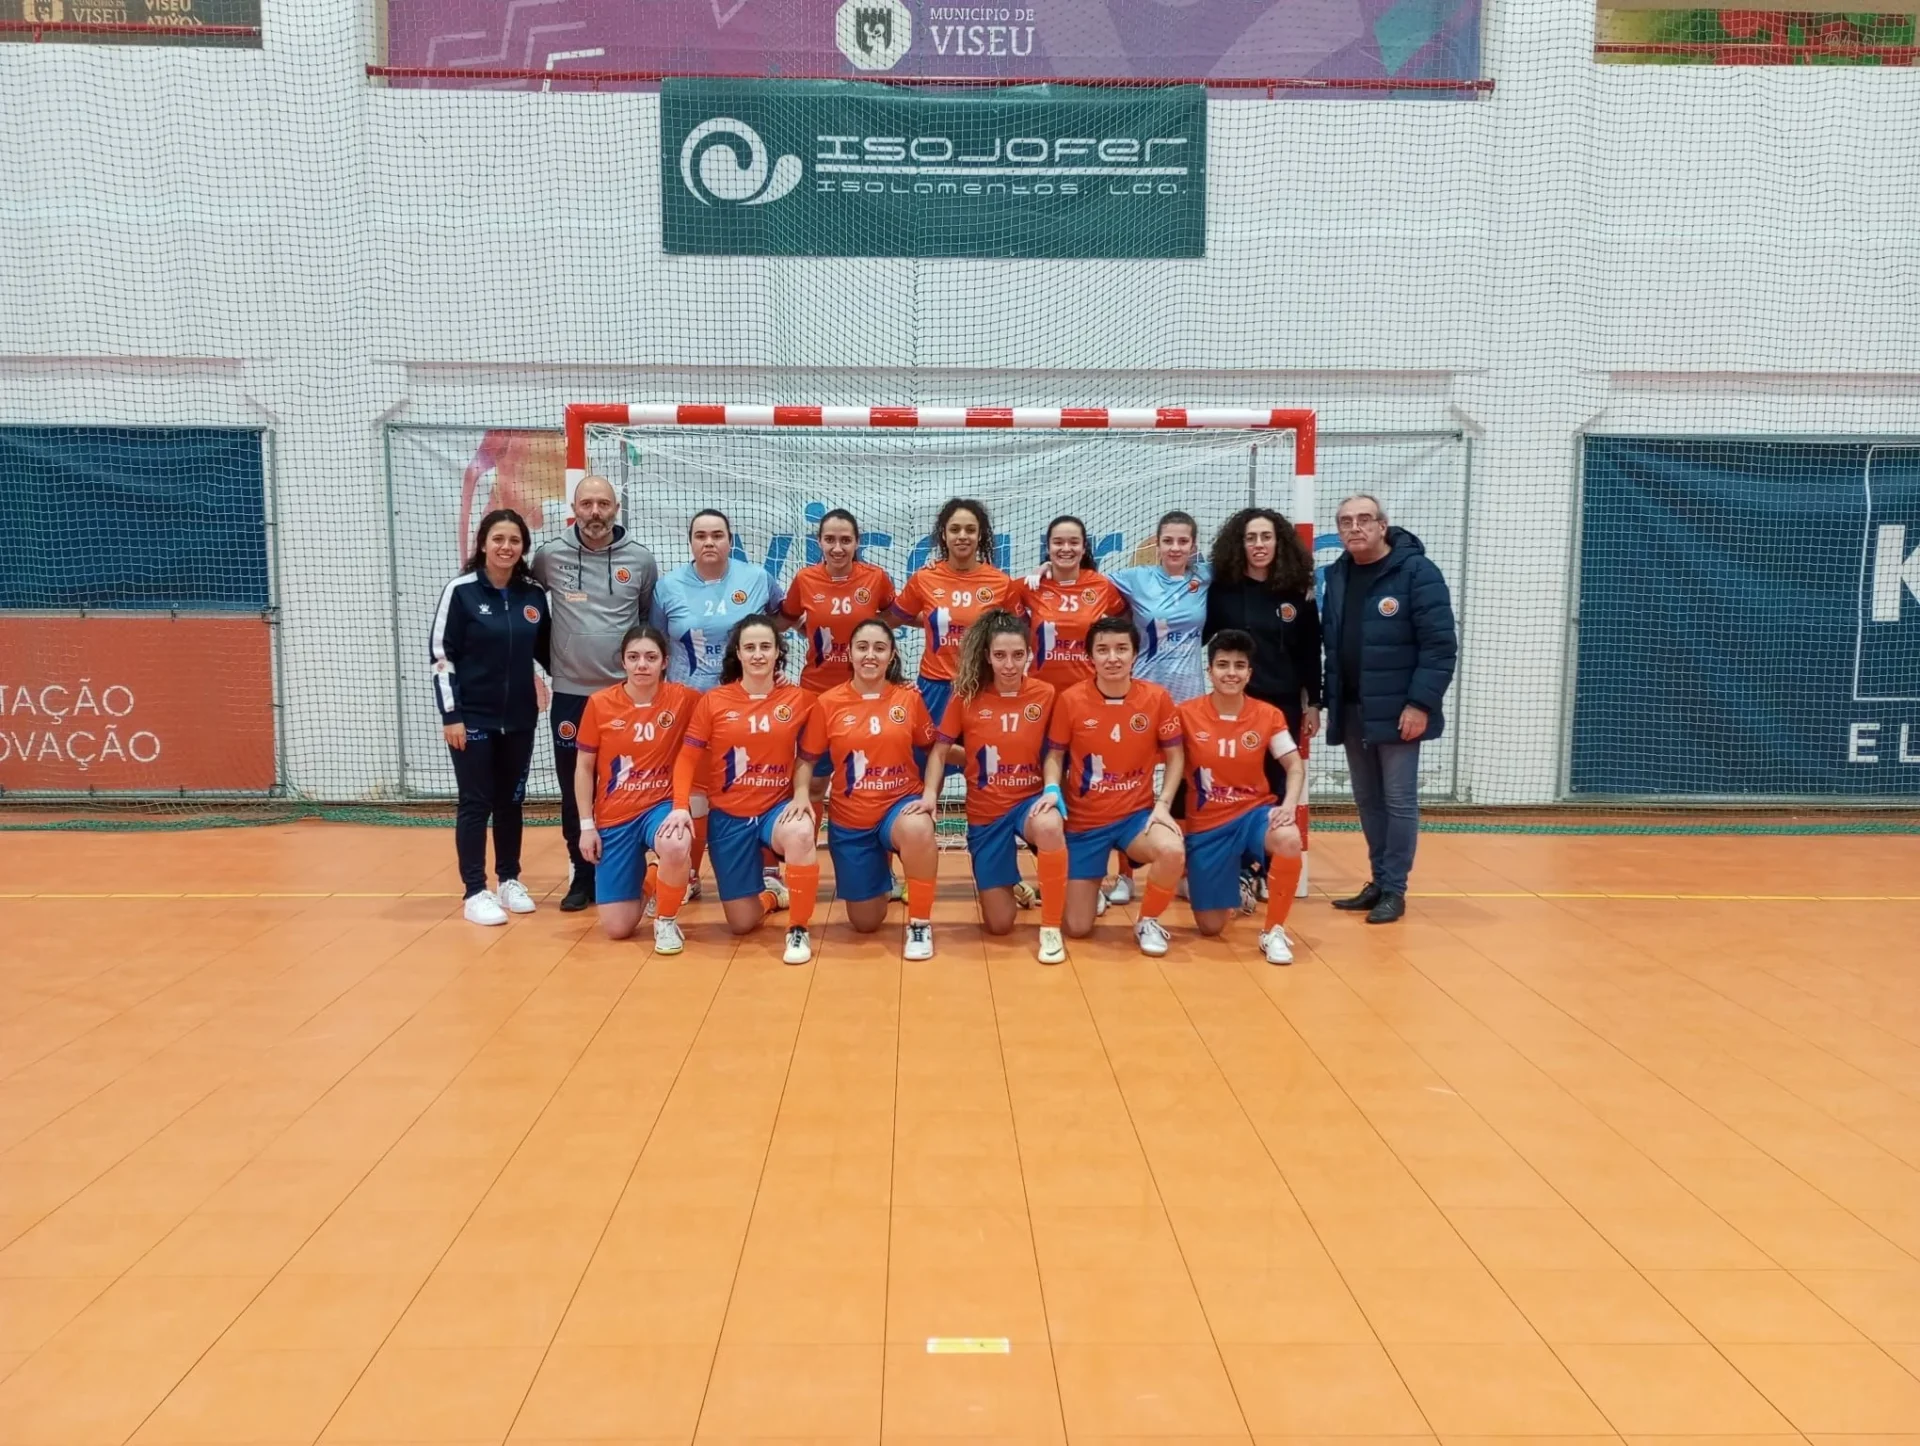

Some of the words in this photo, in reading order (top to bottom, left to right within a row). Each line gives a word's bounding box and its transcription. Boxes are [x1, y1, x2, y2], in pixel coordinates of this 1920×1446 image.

[72, 8, 127, 24] VISEU
[930, 4, 1010, 20] MUNICÍPIO
[1015, 8, 1034, 20] DE
[929, 25, 1035, 56] VISEU
[703, 600, 727, 617] 24
[831, 596, 852, 615] 26
[951, 590, 972, 608] 99
[1058, 594, 1079, 612] 25
[1045, 650, 1090, 661] Dinâmic
[633, 722, 655, 742] 20
[748, 714, 770, 734] 14
[870, 716, 881, 735] 8
[1000, 713, 1019, 732] 17
[1110, 723, 1121, 742] 4
[1218, 738, 1236, 758] 11
